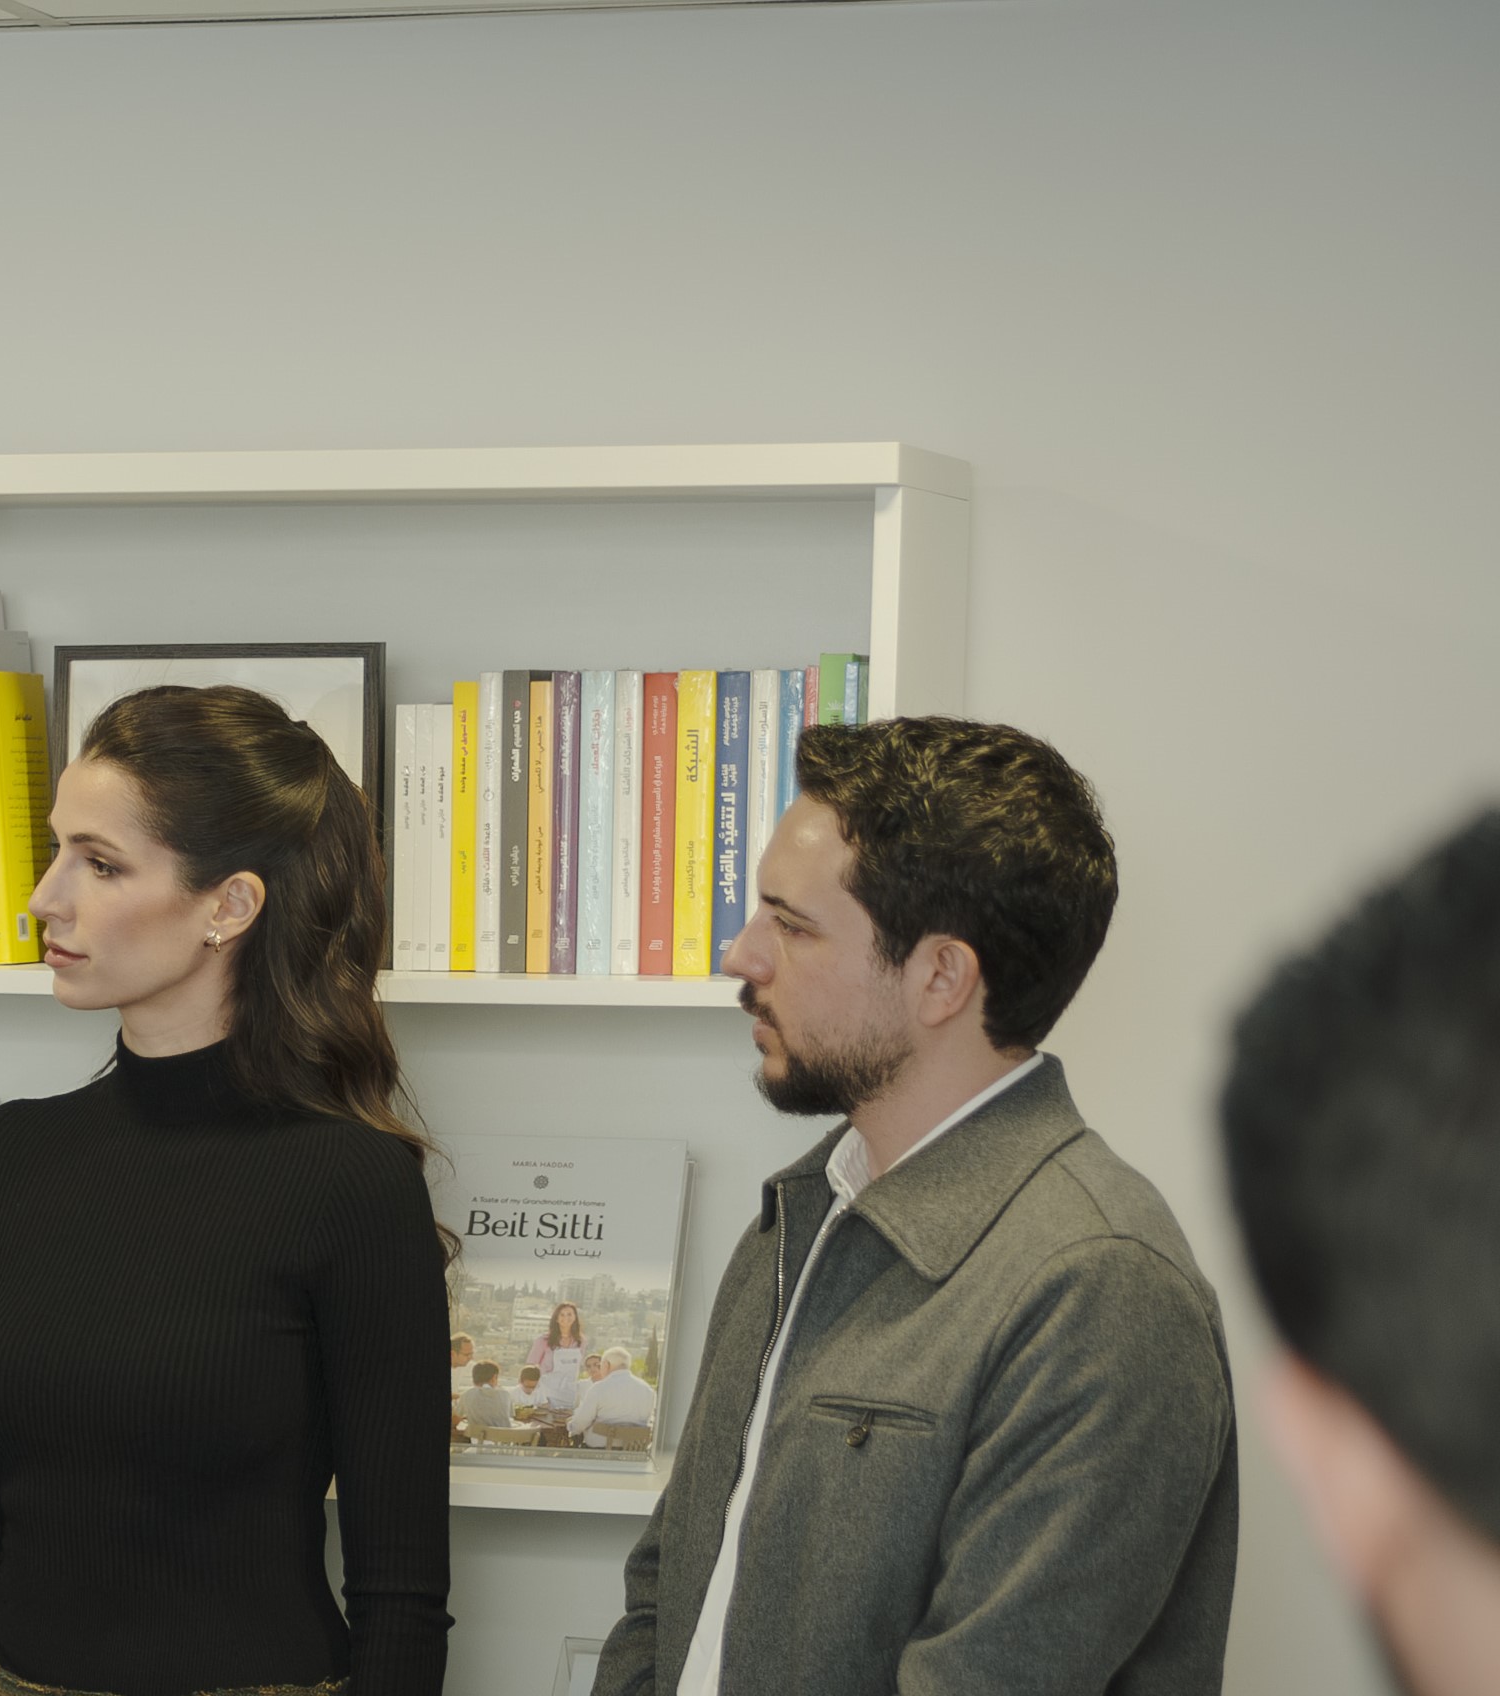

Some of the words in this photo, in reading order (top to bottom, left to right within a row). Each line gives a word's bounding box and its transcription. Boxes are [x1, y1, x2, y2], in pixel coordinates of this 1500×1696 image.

[512, 710, 522, 723] حب
[685, 729, 702, 783] الشبكة
[510, 748, 521, 782] الشعارات
[721, 791, 736, 805] لا
[720, 849, 738, 904] بالقواعد
[512, 1160, 538, 1168] MARIA
[540, 1161, 575, 1169] HADDAD
[510, 1198, 521, 1206] my
[578, 1199, 606, 1207] Homes
[464, 1209, 530, 1238] Beit
[535, 1212, 604, 1241] Sitti
[573, 1247, 602, 1259] بيت
